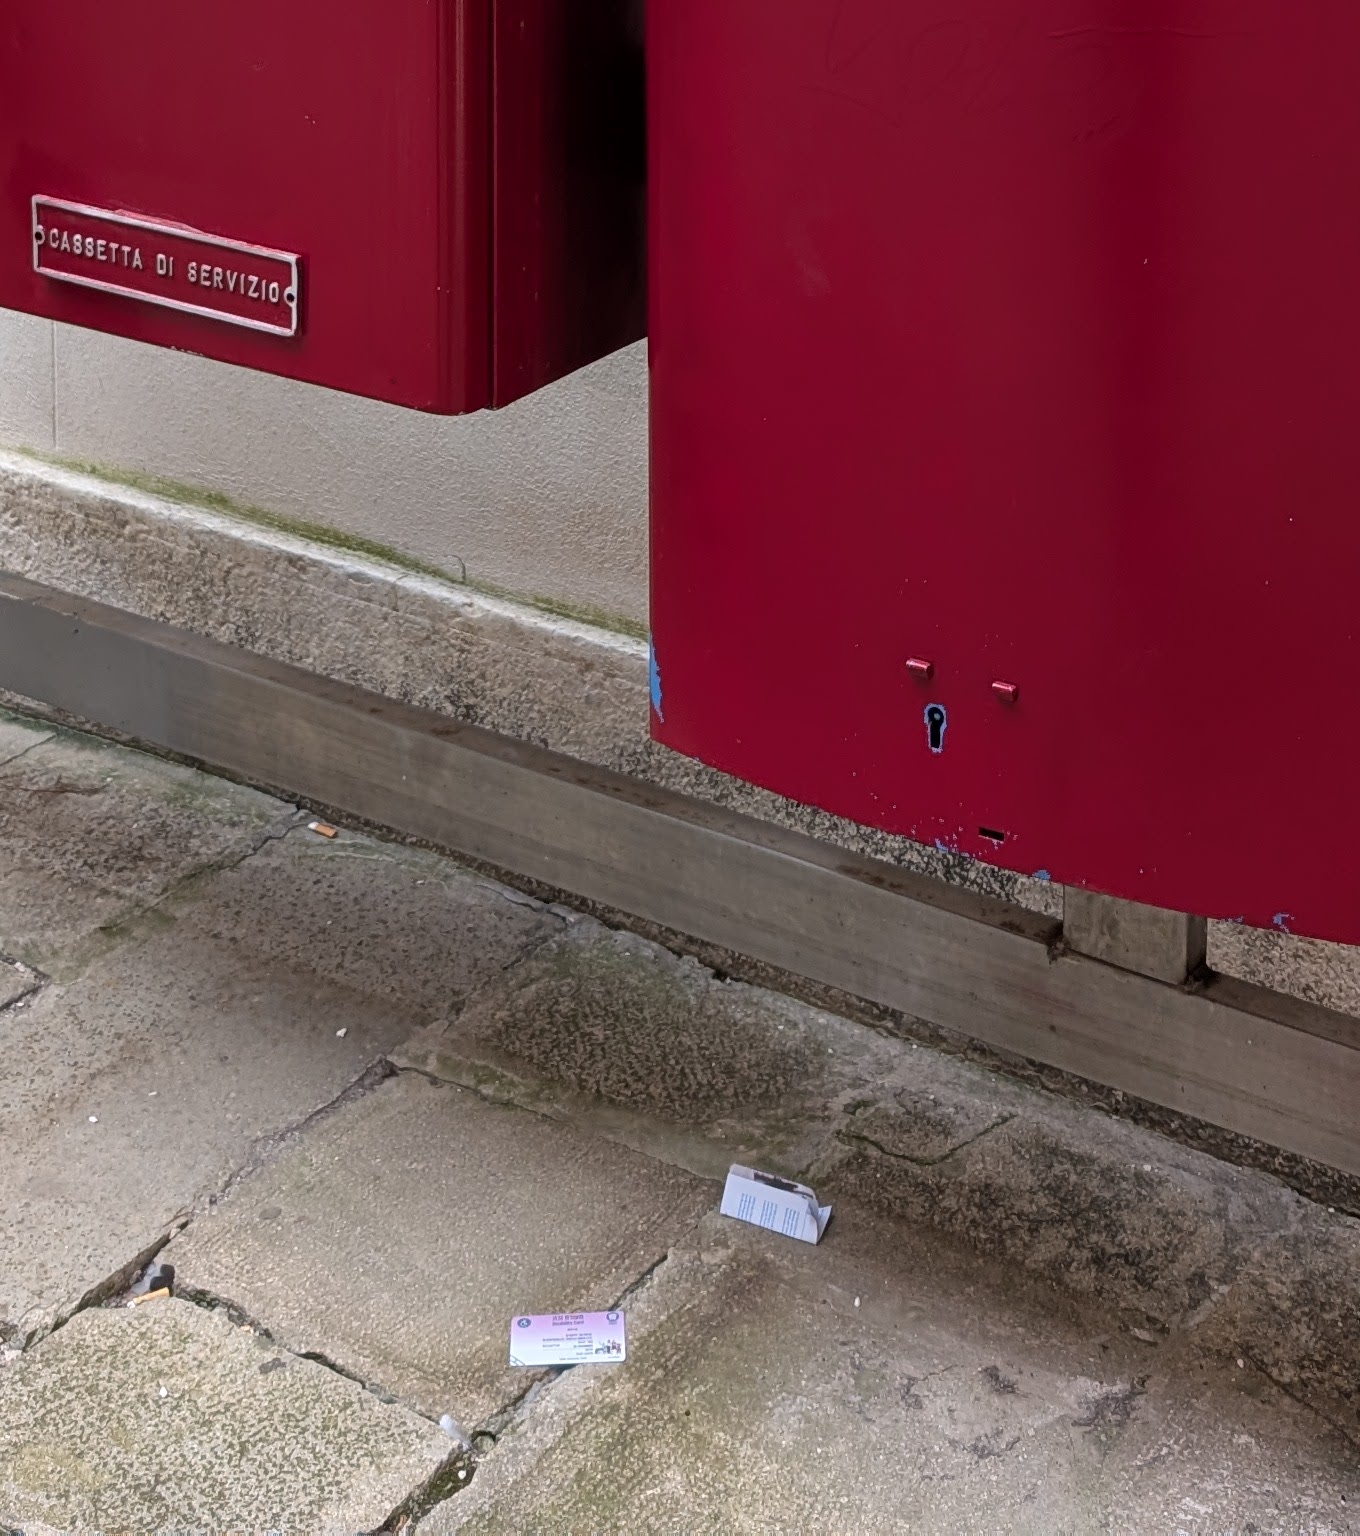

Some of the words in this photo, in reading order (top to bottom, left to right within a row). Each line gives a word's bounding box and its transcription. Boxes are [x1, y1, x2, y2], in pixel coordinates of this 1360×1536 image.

[49, 228, 143, 269] CASSETTA
[156, 254, 173, 277] DI
[187, 262, 280, 303] SERVIZIO
